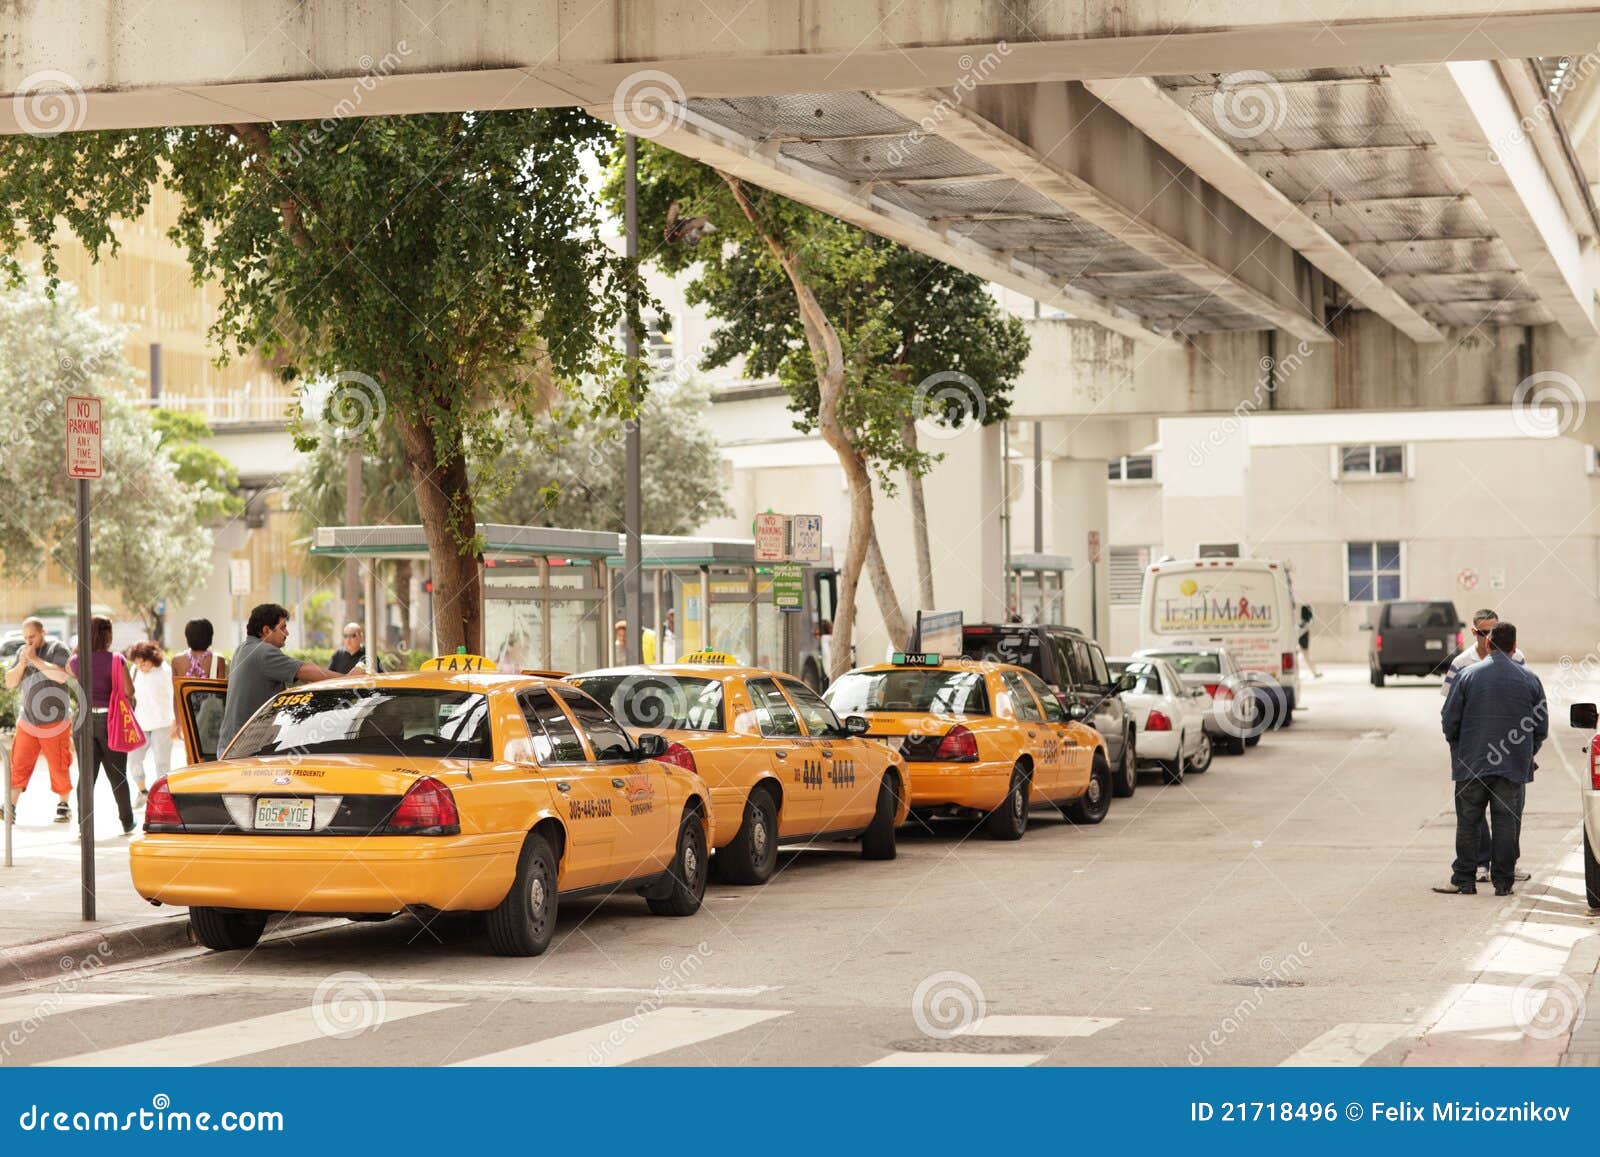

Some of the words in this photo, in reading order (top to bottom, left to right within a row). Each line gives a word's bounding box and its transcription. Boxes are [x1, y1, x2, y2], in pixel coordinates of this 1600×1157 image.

[77, 402, 90, 418] NO
[69, 419, 99, 435] PARKING
[77, 436, 91, 446] ANY
[76, 447, 92, 459] TIME
[764, 517, 776, 526] NO
[758, 526, 782, 536] PARKING
[435, 657, 483, 671] TAXI
[905, 655, 925, 663] TAXI
[272, 693, 314, 708] 3156
[293, 769, 326, 777] FREQUENTLY
